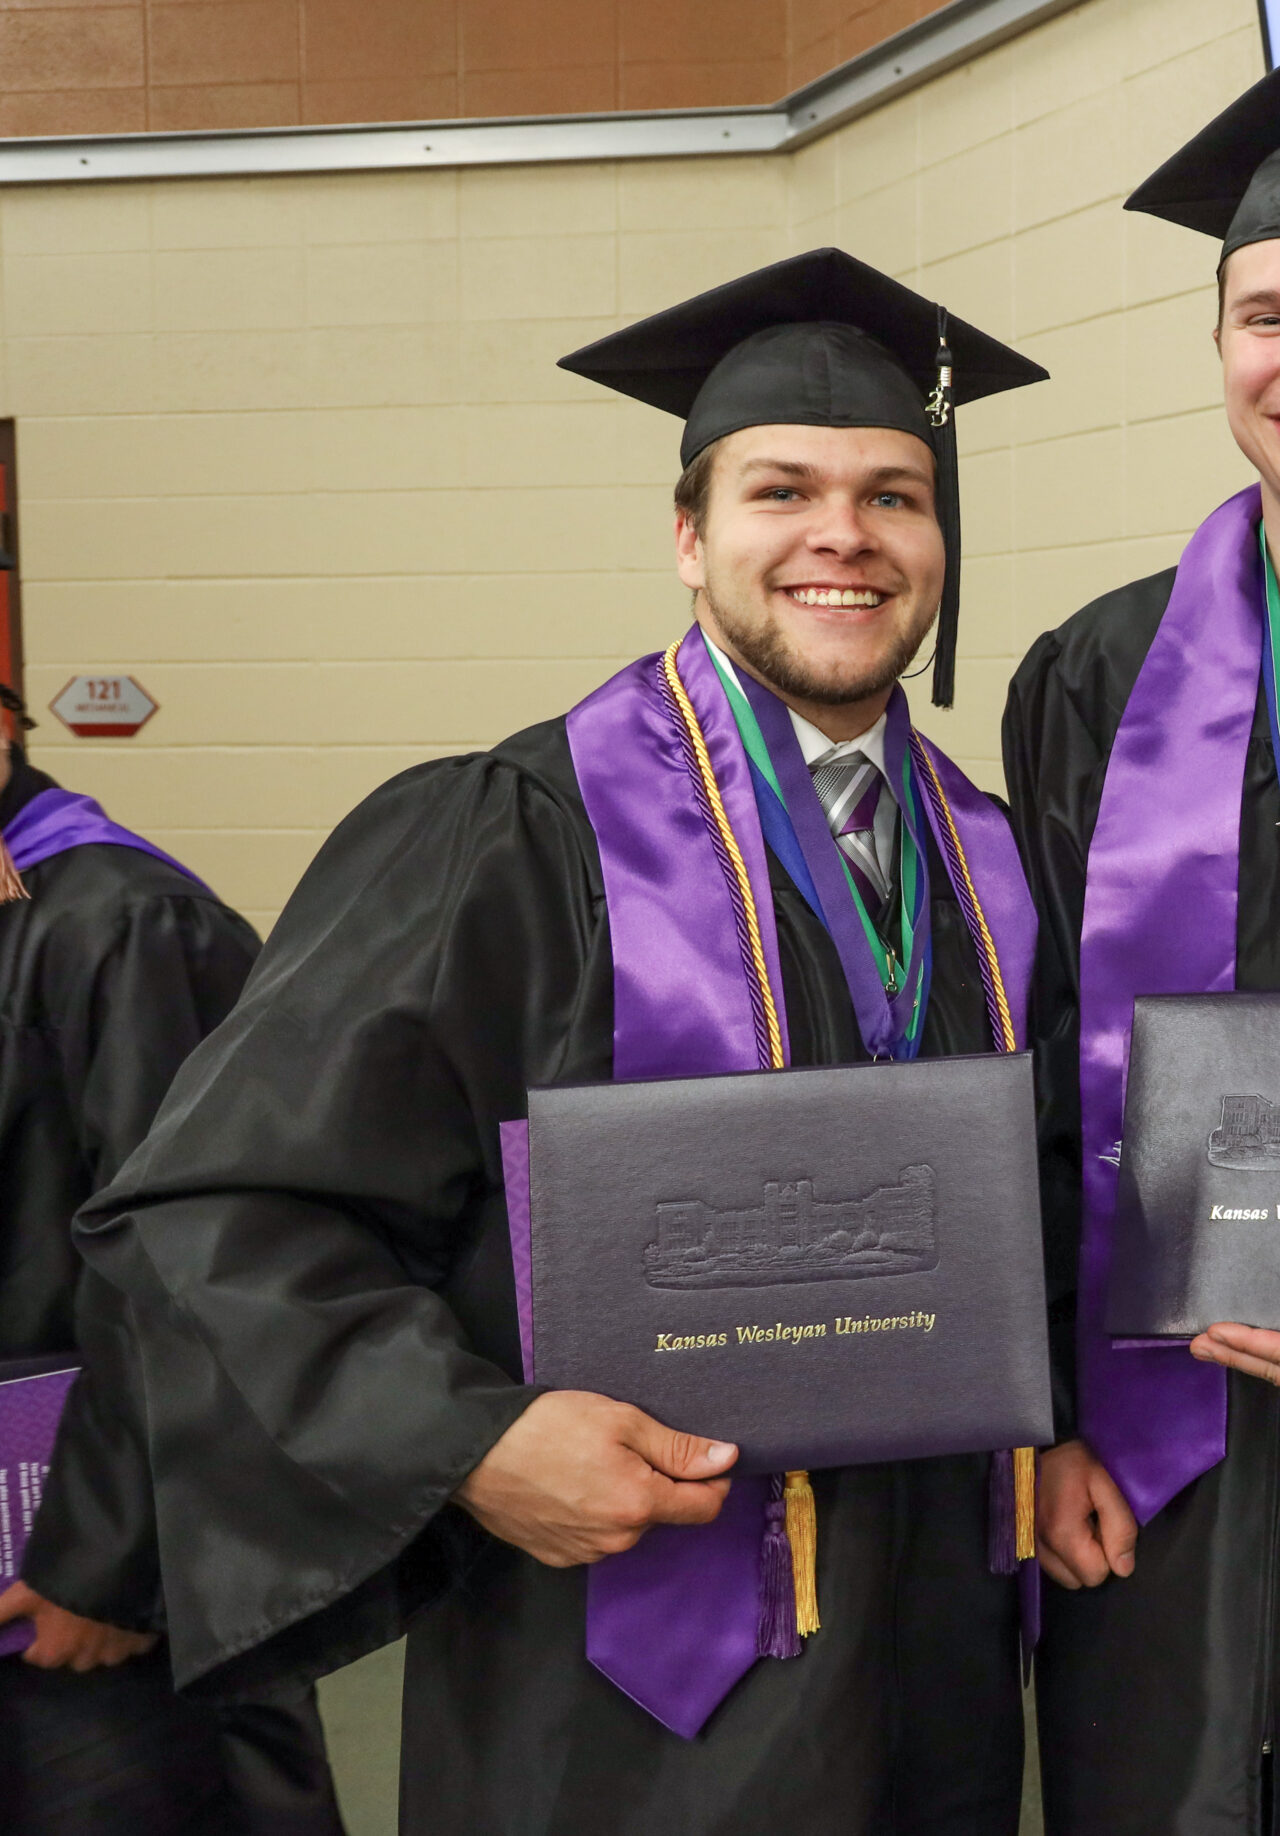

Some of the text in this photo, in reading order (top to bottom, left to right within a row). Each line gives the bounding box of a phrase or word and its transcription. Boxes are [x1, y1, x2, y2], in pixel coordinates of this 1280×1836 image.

[87, 680, 120, 700] 121
[1210, 1205, 1268, 1221] Kansas
[655, 1310, 937, 1352] Kansas Wesleyan University
